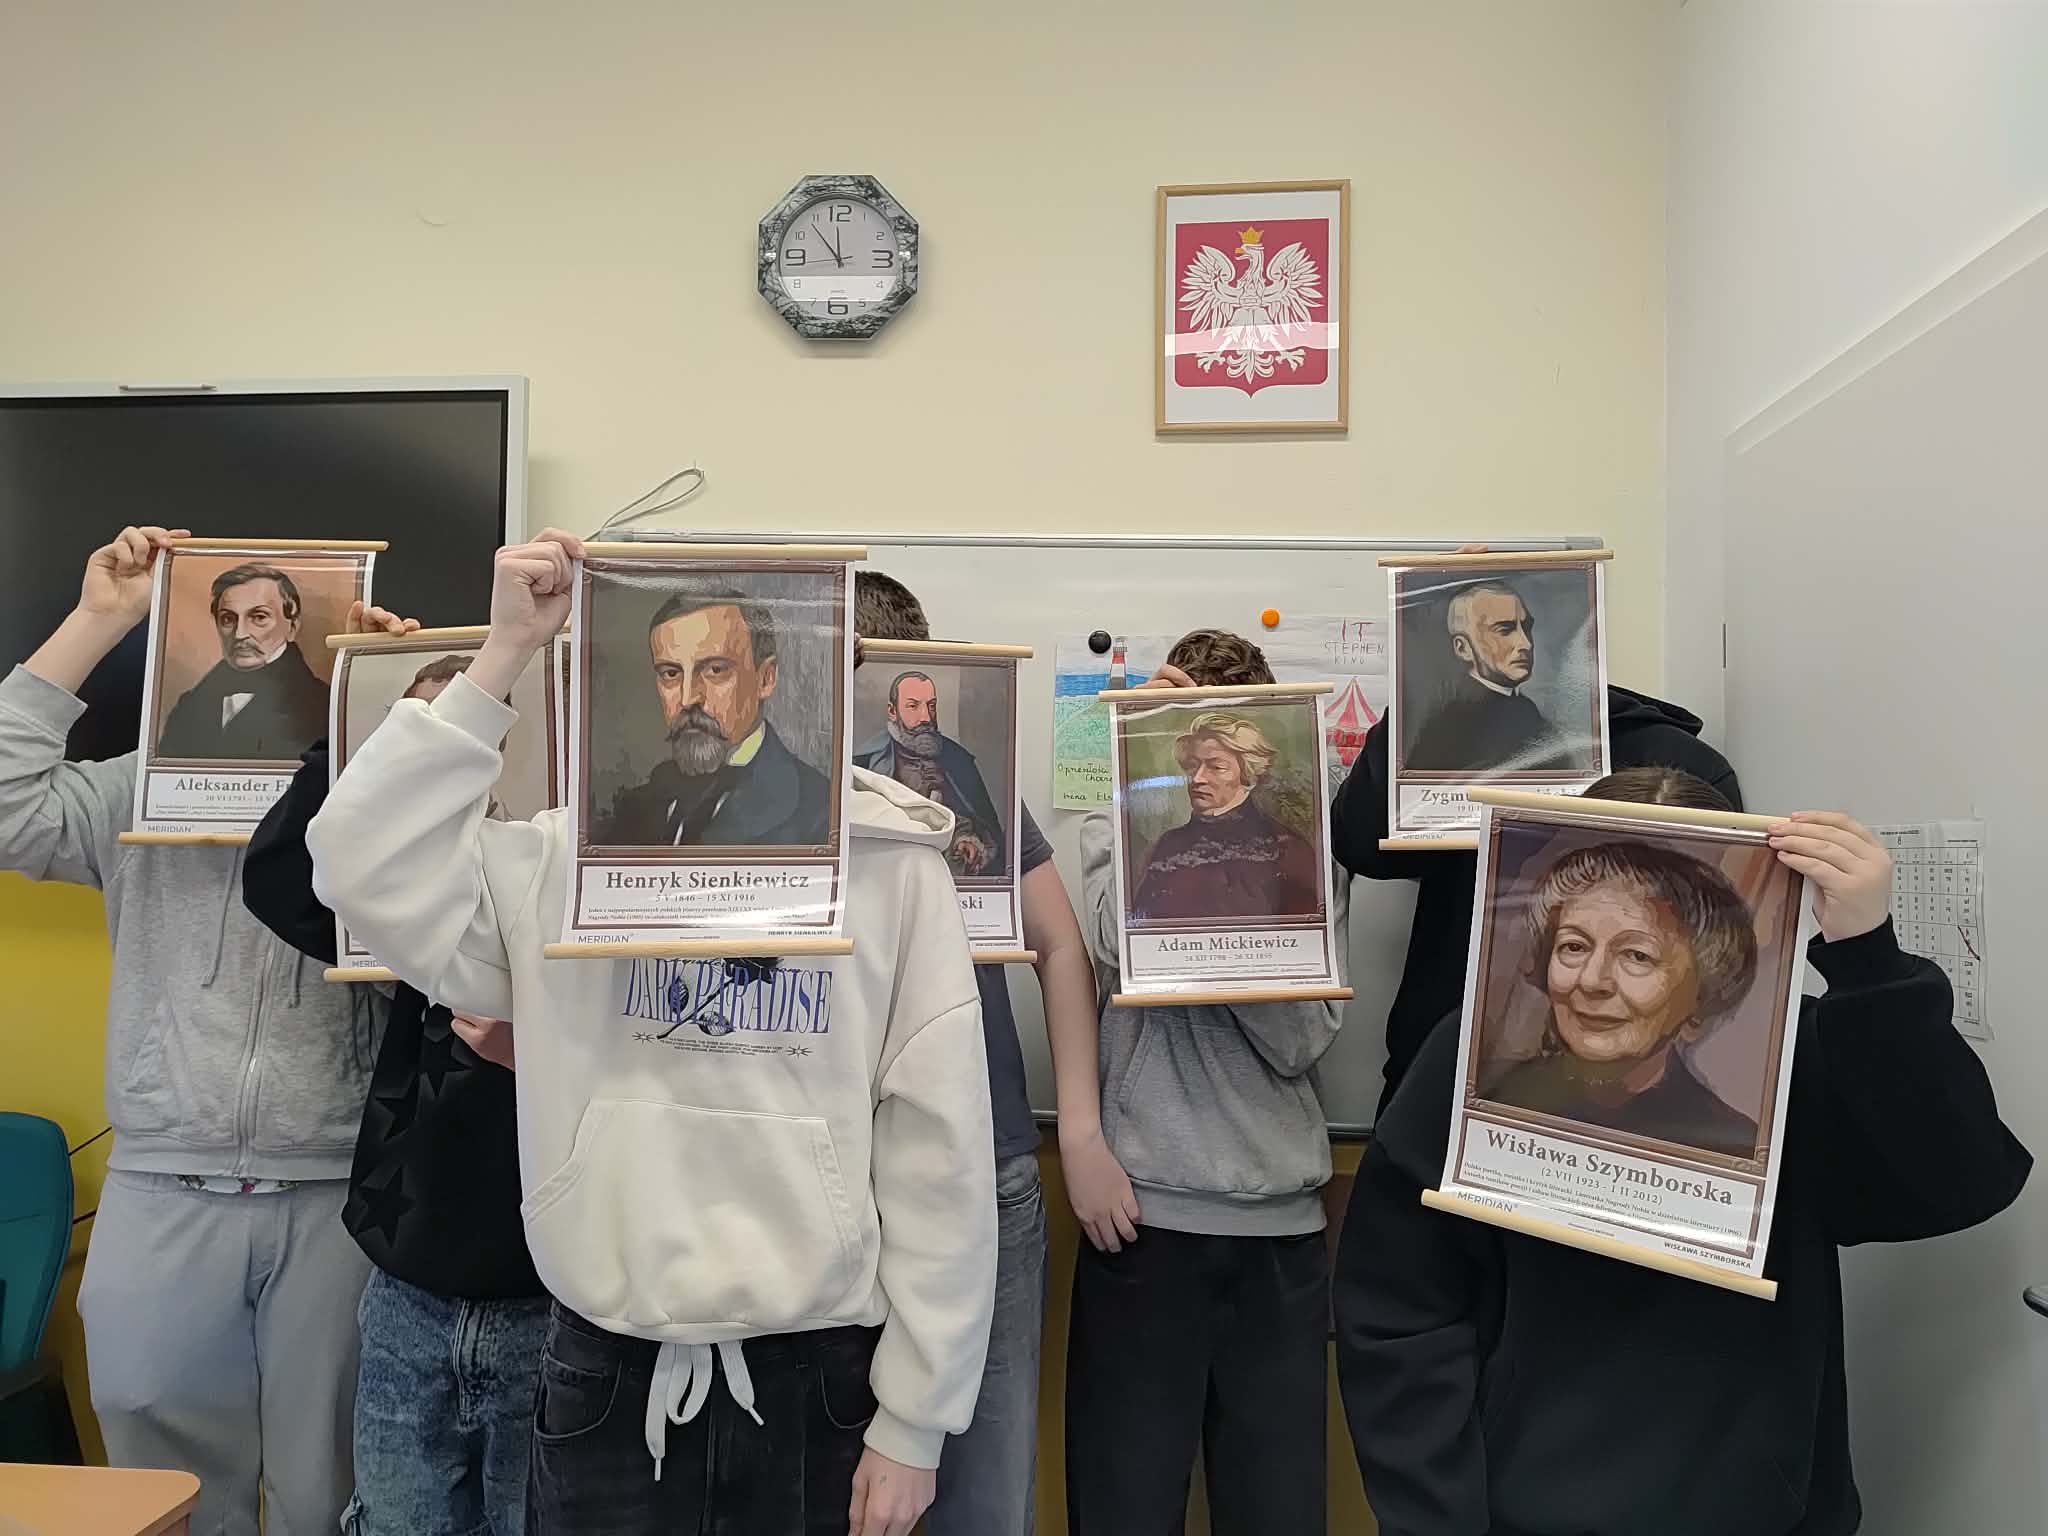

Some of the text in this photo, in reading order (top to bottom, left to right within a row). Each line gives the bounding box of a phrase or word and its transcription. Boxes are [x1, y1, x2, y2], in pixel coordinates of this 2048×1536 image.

[813, 214, 819, 222] 11
[829, 205, 852, 222] 12
[795, 232, 806, 241] 10
[877, 232, 885, 241] 2
[786, 249, 806, 267] 9
[872, 250, 894, 269] 3
[828, 298, 848, 315] 6
[859, 298, 866, 307] 5
[1342, 618, 1376, 641] IT
[1324, 641, 1384, 655] STEPHEN
[175, 778, 269, 794] Aleksander
[1421, 789, 1471, 805] Zygm
[606, 871, 809, 893] Henryk Sienkiewicz
[578, 935, 629, 944] MERIDIAN
[1158, 935, 1297, 953] Adam Mickiewicz
[621, 958, 833, 1034] DARK PARADISE
[1485, 1128, 1732, 1205] Wisława Szymborska
[1541, 1167, 1551, 1178] (2
[1555, 1170, 1572, 1182] VII
[1576, 1176, 1600, 1189] 1923
[1620, 1187, 1628, 1195] II
[1633, 1190, 1663, 1206] 2012)
[1457, 1191, 1513, 1212] MERIDIAN
[1664, 1241, 1751, 1269] WISŁAWA SZYMBORSKA
